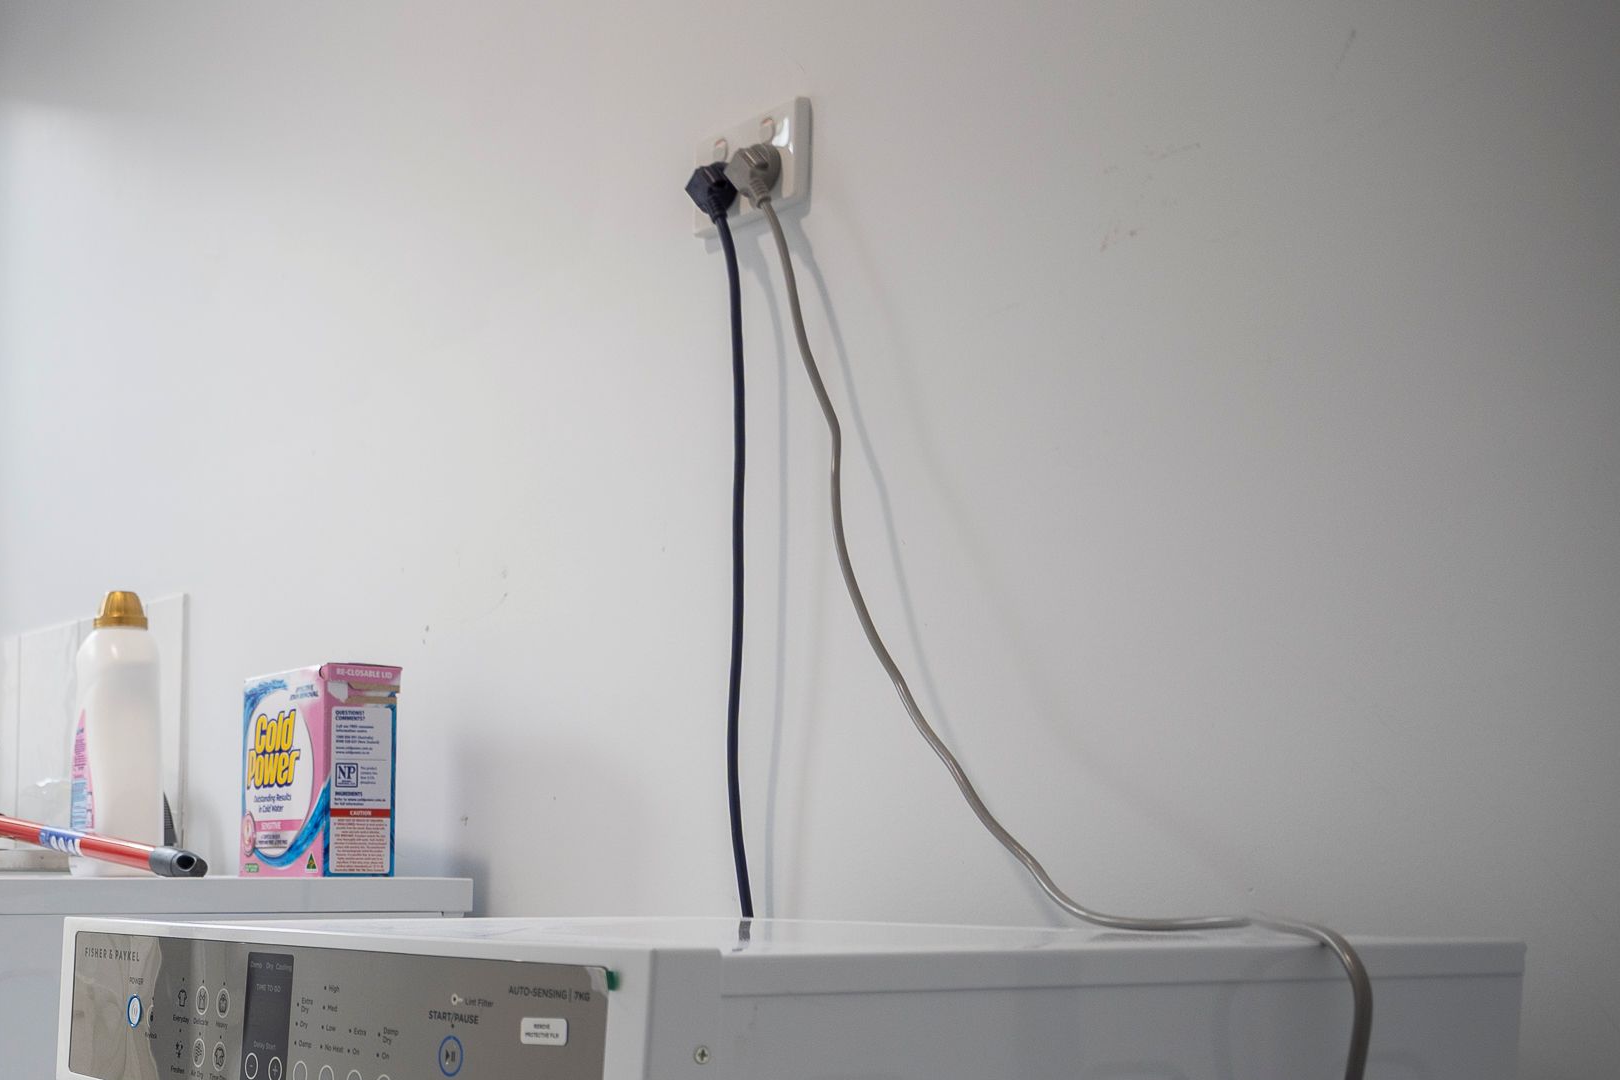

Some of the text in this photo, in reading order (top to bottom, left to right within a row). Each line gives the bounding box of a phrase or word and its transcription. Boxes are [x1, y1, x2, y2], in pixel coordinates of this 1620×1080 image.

[336, 668, 379, 678] RE-CLOSABLE
[255, 709, 296, 754] Cold
[247, 749, 300, 790] Power
[338, 766, 355, 779] NP
[276, 793, 291, 801] Results
[84, 947, 108, 958] FISHER
[115, 950, 140, 962] PAYKEL
[329, 984, 340, 993] High
[508, 986, 591, 1002] AUTO-SENSING 7KG
[302, 997, 313, 1005] Extra
[478, 999, 494, 1008] Filter
[301, 1005, 309, 1014] Dry
[173, 1014, 189, 1024] Everyday
[429, 1011, 479, 1025] START/PAUSE
[300, 1021, 308, 1029] Dry
[354, 1028, 366, 1036] Extra
[384, 1027, 399, 1037] Damp
[298, 1040, 312, 1049] Damp
[382, 1036, 392, 1045] Dry
[382, 1052, 389, 1060] On
[196, 1072, 204, 1080] Dry
